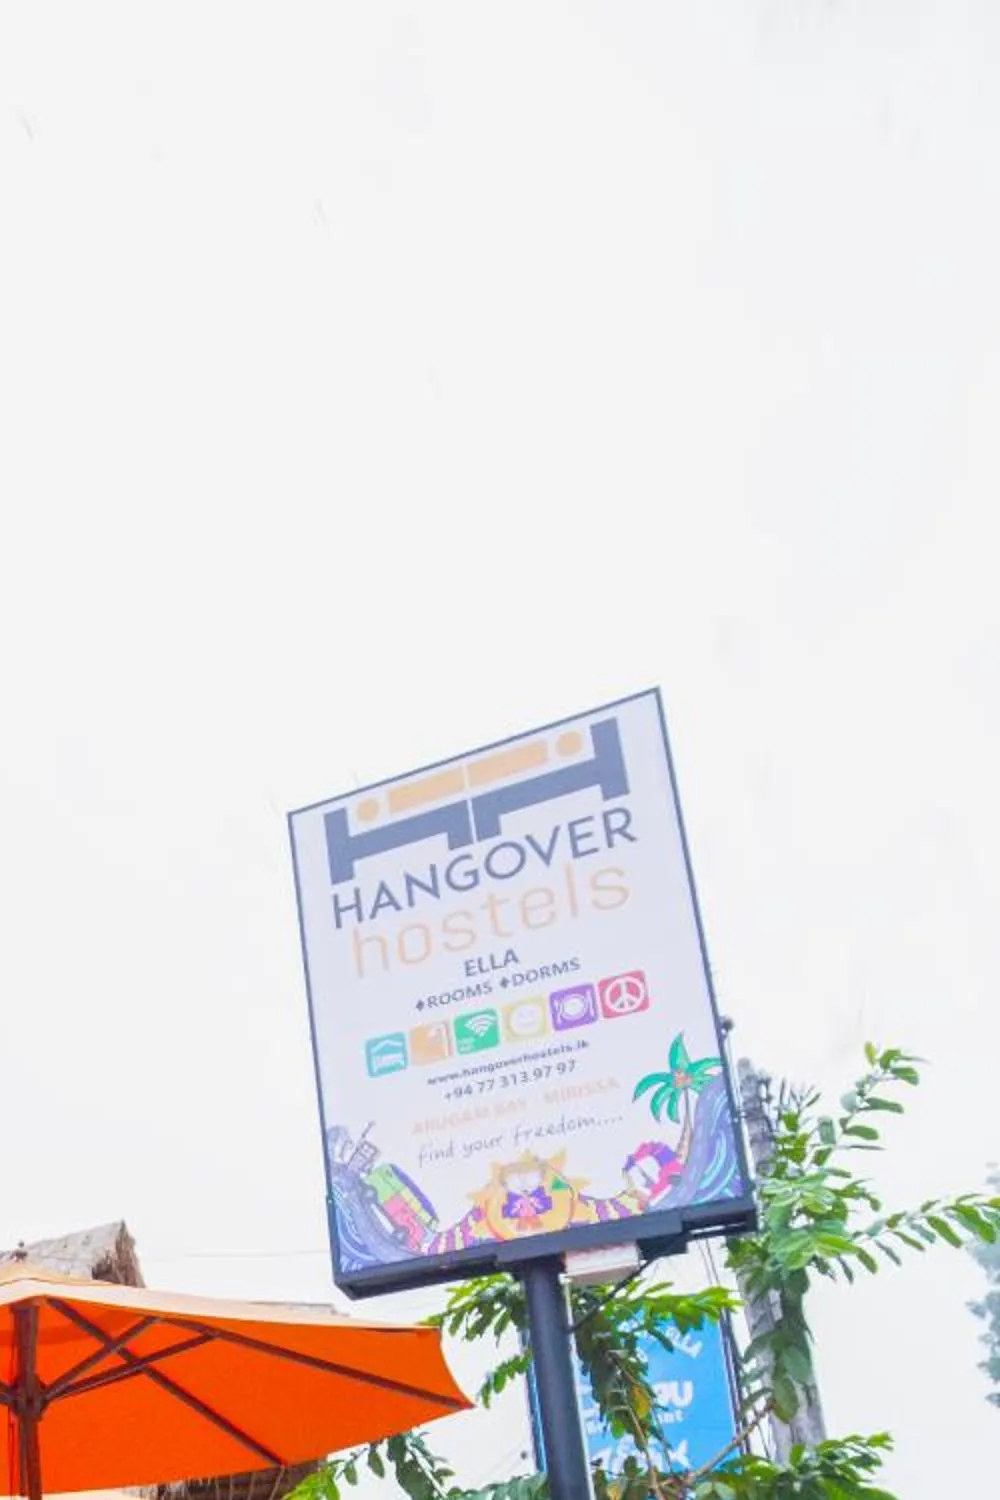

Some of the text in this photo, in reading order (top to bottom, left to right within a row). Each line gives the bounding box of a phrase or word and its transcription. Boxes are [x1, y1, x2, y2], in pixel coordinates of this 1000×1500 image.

[332, 807, 638, 930] HANGOVER
[353, 862, 631, 979] hostels
[464, 948, 520, 978] ELLA
[443, 1059, 577, 1100] +94 77 313 97 97
[417, 1138, 455, 1168] find
[462, 1133, 505, 1159] your
